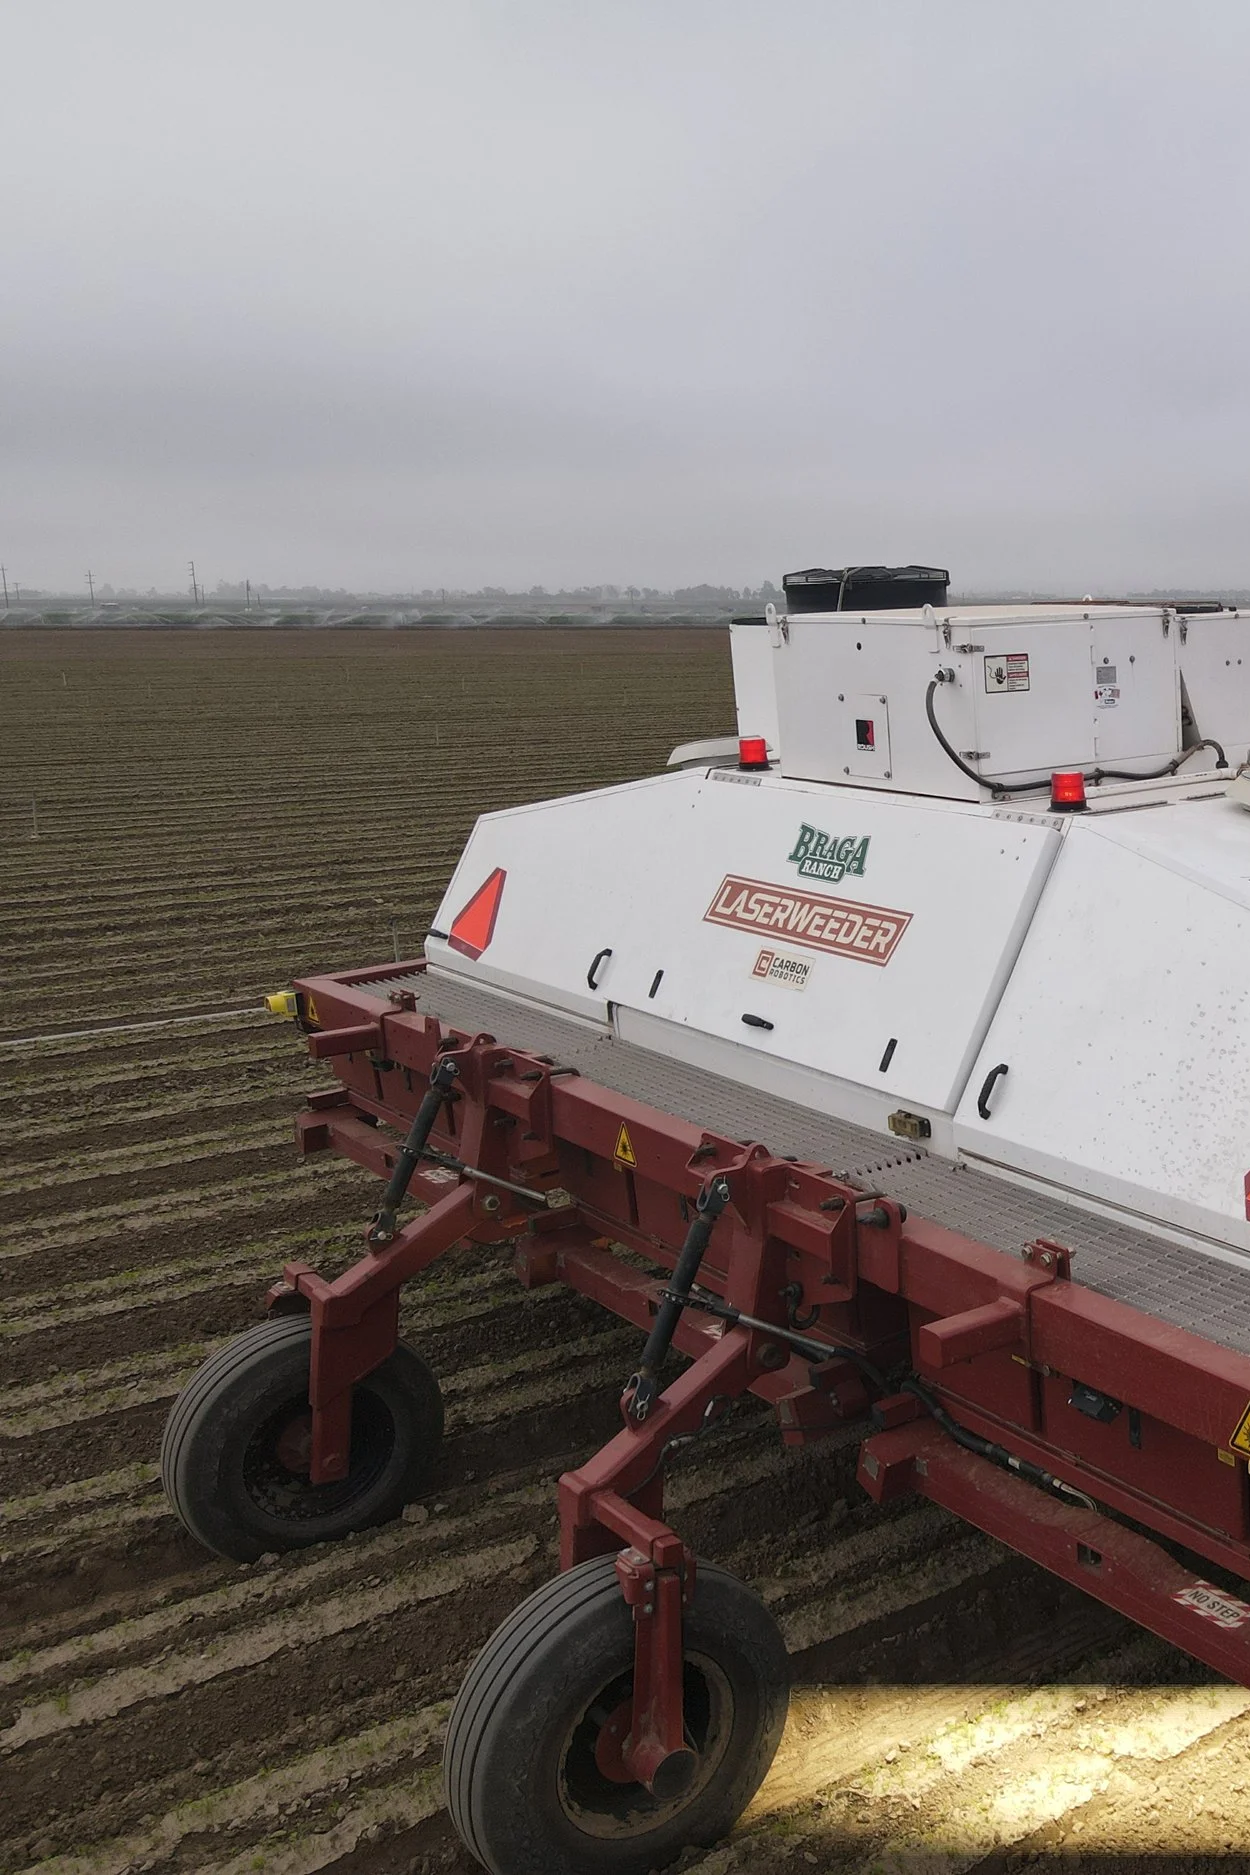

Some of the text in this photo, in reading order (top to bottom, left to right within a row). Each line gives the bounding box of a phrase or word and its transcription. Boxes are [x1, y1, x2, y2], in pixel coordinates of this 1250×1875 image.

[788, 823, 871, 877] BRAGA
[801, 859, 842, 879] RANCH
[715, 885, 897, 953] LASERWEEDER
[769, 968, 805, 985] ROBOTICS
[772, 957, 810, 976] CARBON
[1188, 1590, 1240, 1619] NO STEP
